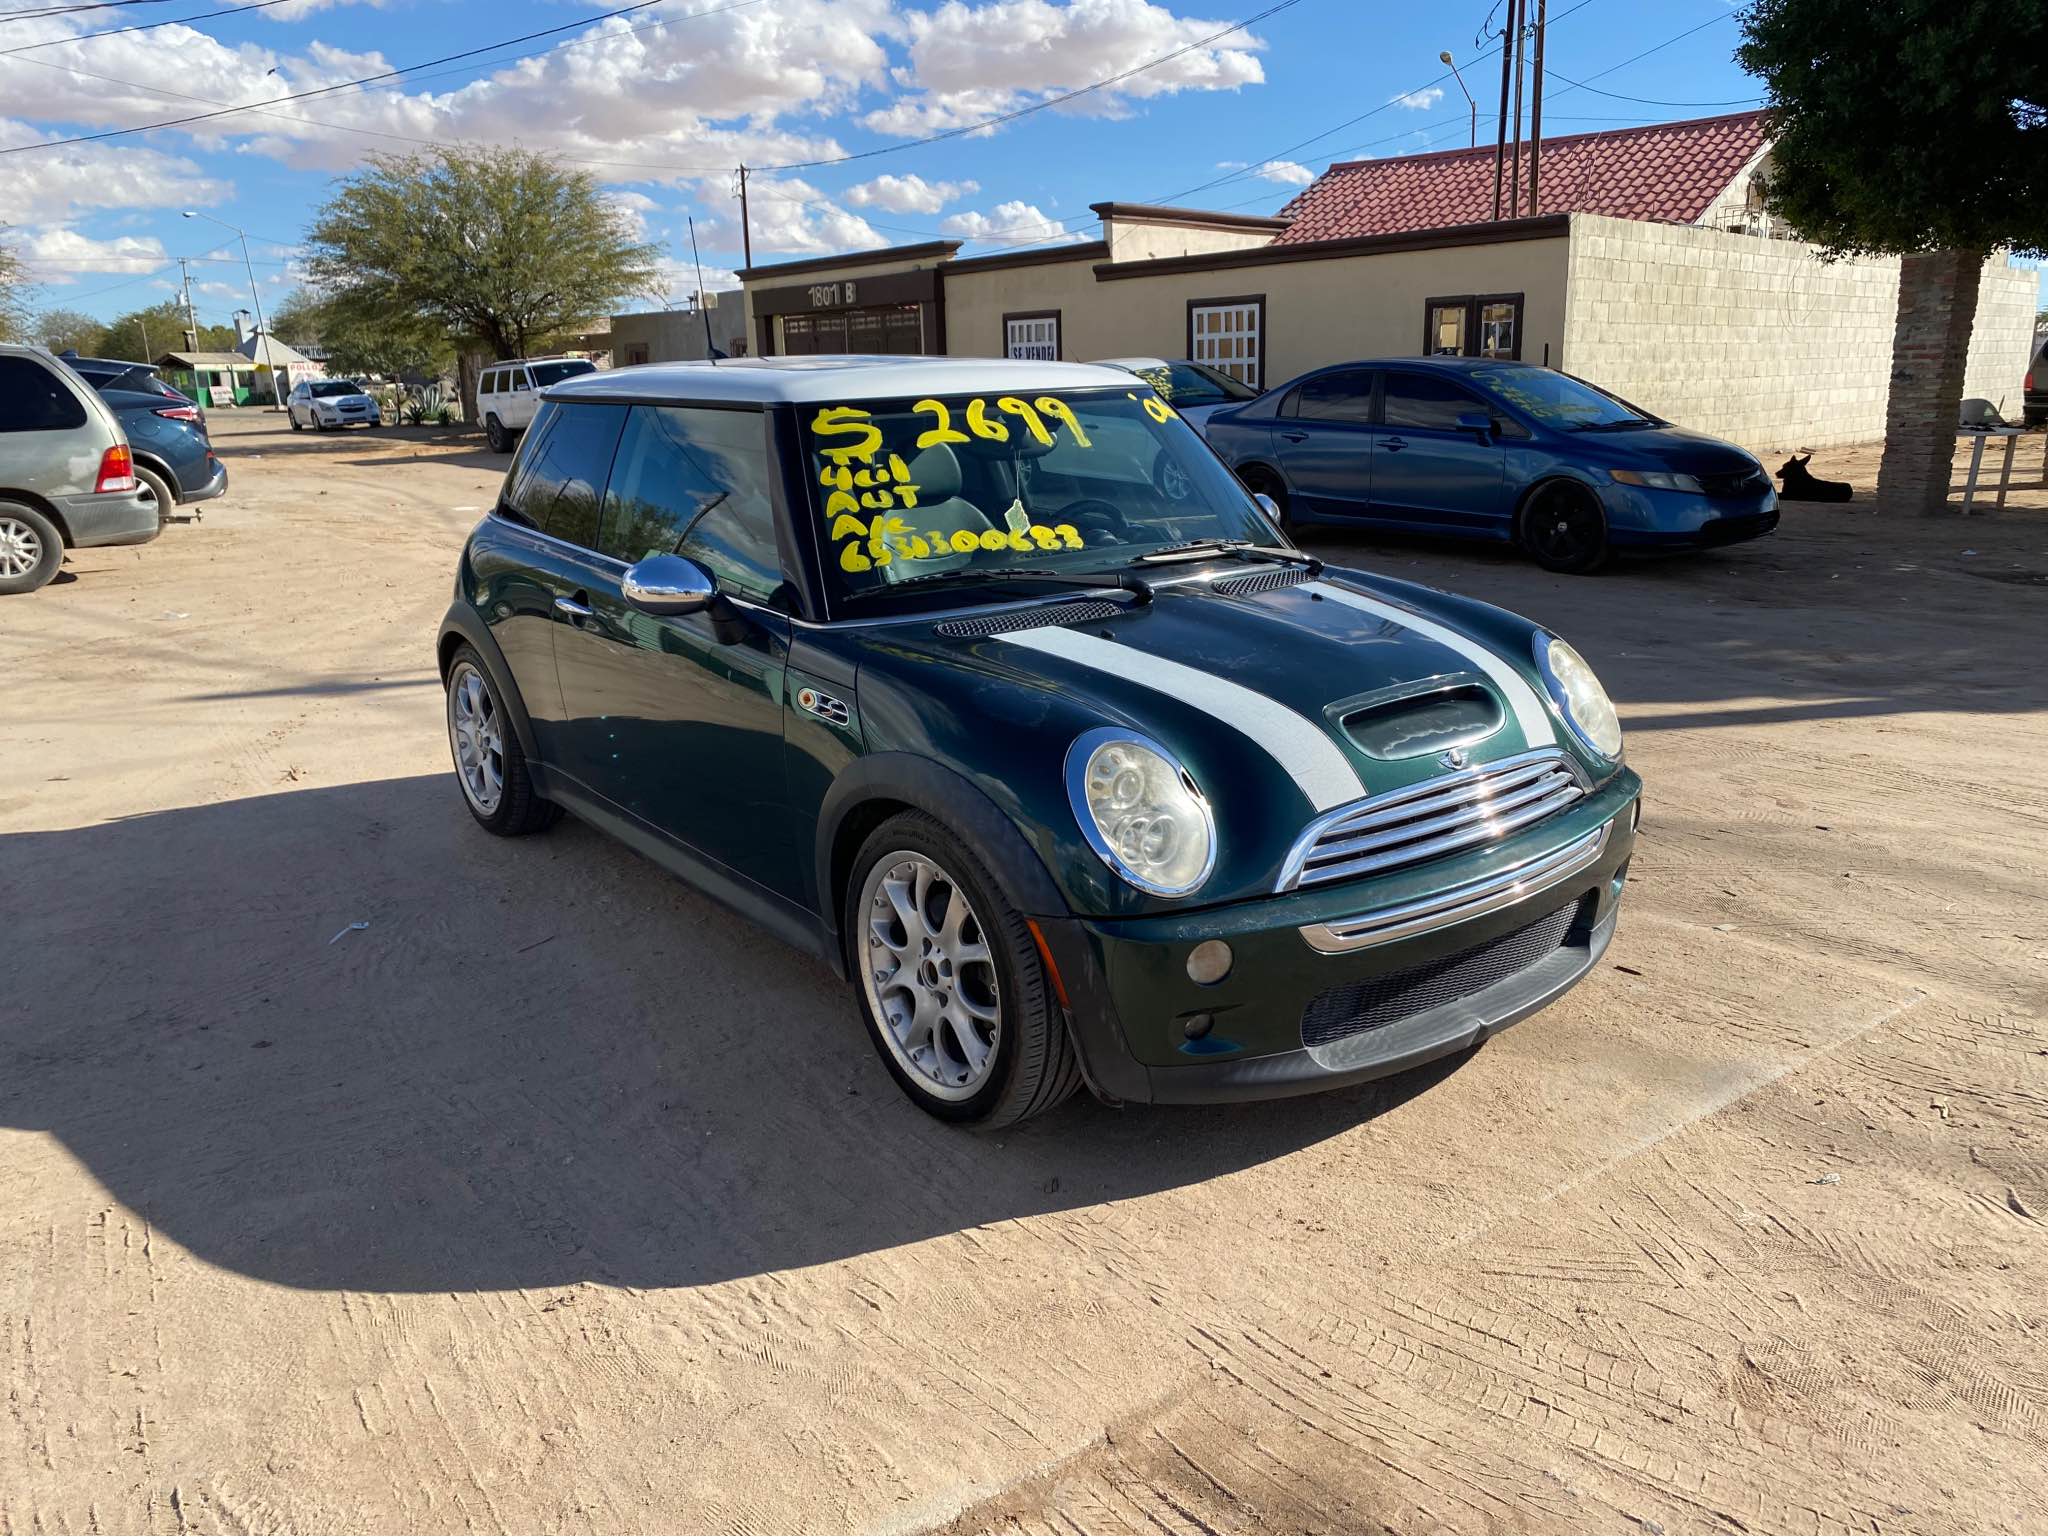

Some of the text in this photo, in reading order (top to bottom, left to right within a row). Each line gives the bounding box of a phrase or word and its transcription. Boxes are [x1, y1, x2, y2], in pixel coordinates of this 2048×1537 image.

[808, 282, 856, 307] 1801 B
[912, 396, 1092, 449] 2699
[826, 485, 920, 518] AUT
